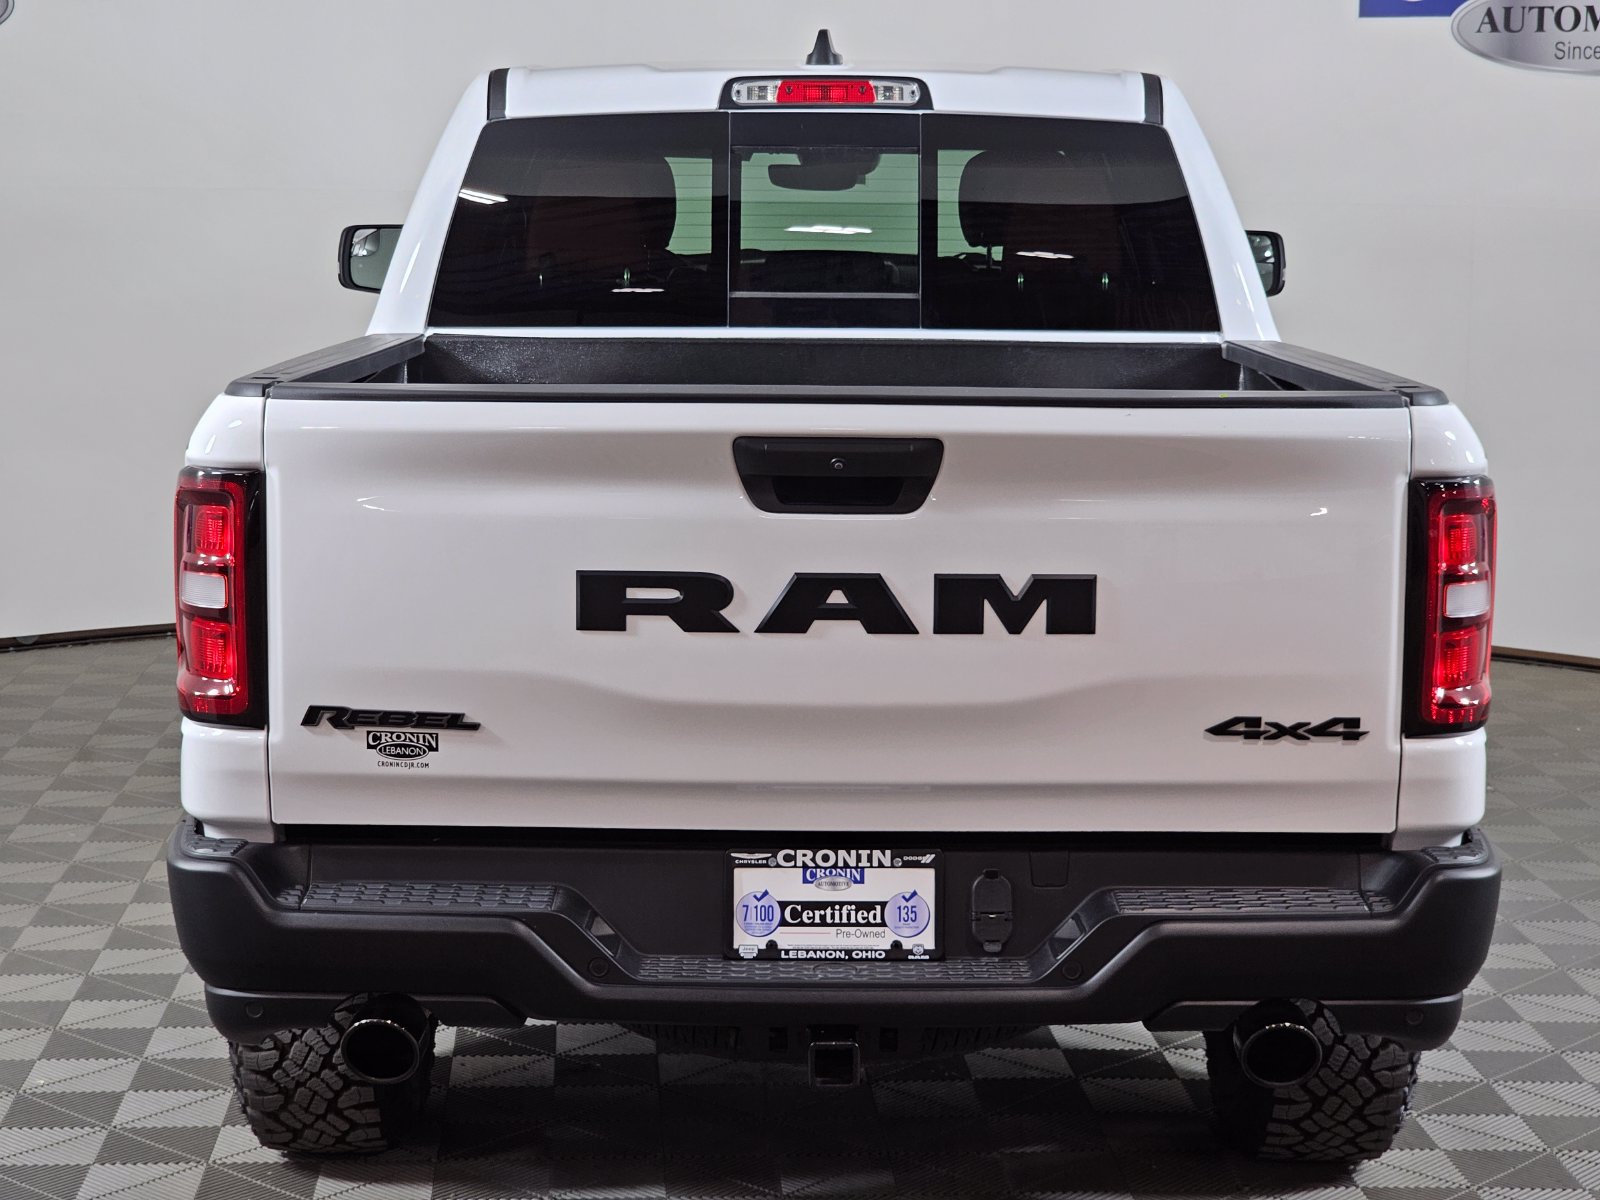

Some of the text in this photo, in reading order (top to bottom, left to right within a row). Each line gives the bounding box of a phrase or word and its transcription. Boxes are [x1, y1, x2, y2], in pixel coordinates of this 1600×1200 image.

[1554, 41, 1600, 60] Since
[575, 570, 1097, 635] RAM
[300, 704, 481, 731] REBEL
[1204, 716, 1370, 741] 4x4
[368, 732, 437, 748] CRONIN
[381, 746, 424, 756] LEBANON
[377, 760, 430, 769] CRONINCDJR.COM
[776, 849, 891, 867] CRONIN
[806, 868, 861, 882] CRONIN
[784, 904, 882, 924] Certified
[897, 905, 917, 923] 135
[835, 928, 886, 939] Pre-Owned
[781, 950, 886, 960] LEBANON, OHIO
